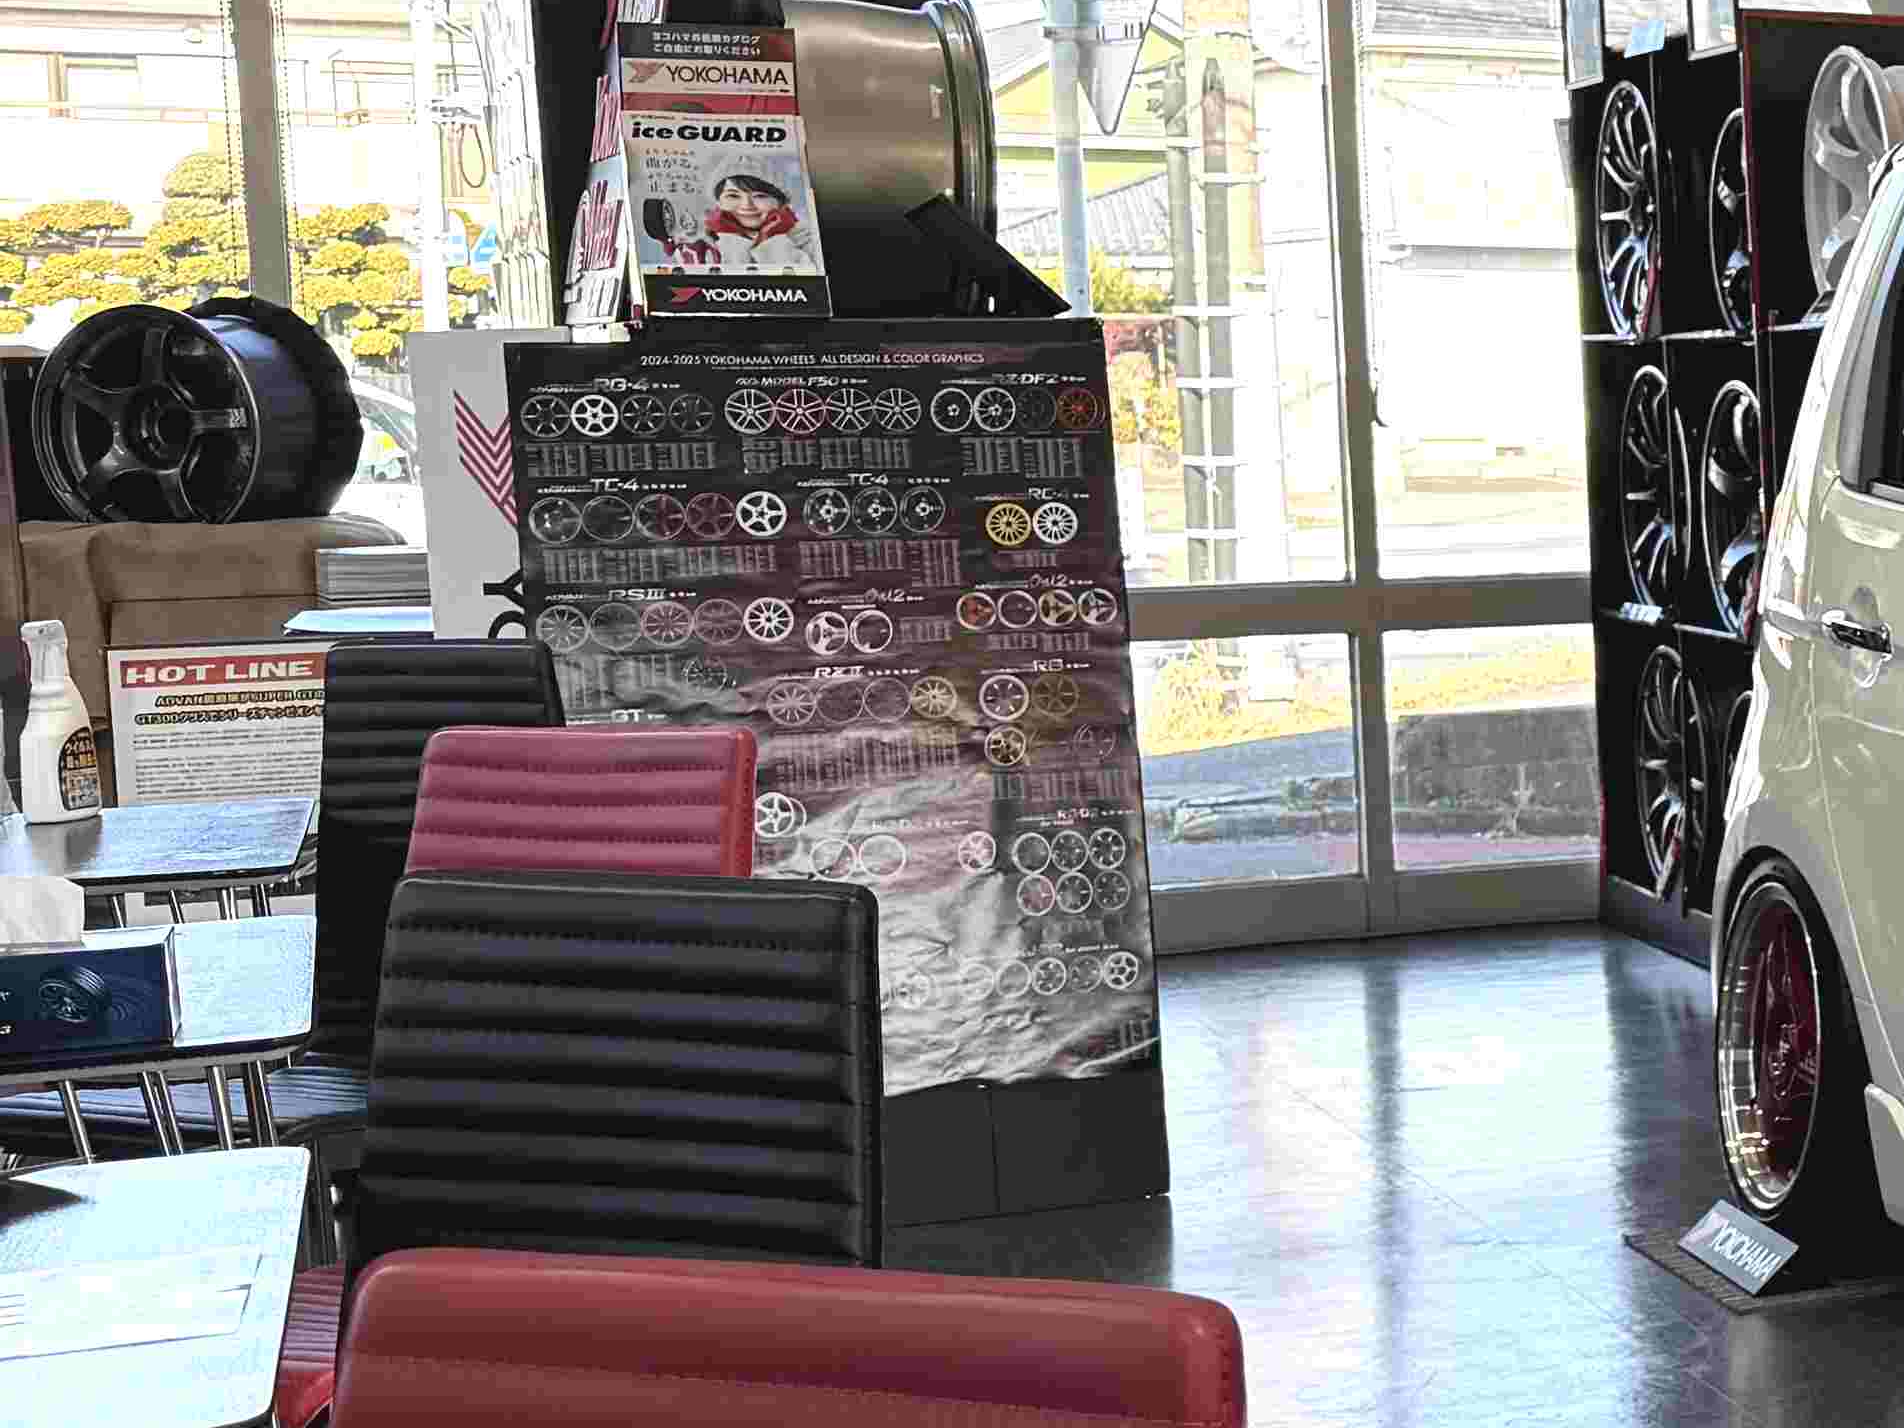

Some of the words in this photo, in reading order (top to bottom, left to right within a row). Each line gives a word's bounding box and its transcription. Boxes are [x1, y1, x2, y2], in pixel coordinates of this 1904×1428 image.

[665, 64, 789, 86] YOKOHAMA
[701, 288, 808, 303] YOKOHAMA
[702, 355, 773, 366] YOKOHAMA
[126, 663, 216, 685] HOT
[224, 659, 314, 680] LINE
[1710, 1219, 1784, 1280] YOKOHAMA
